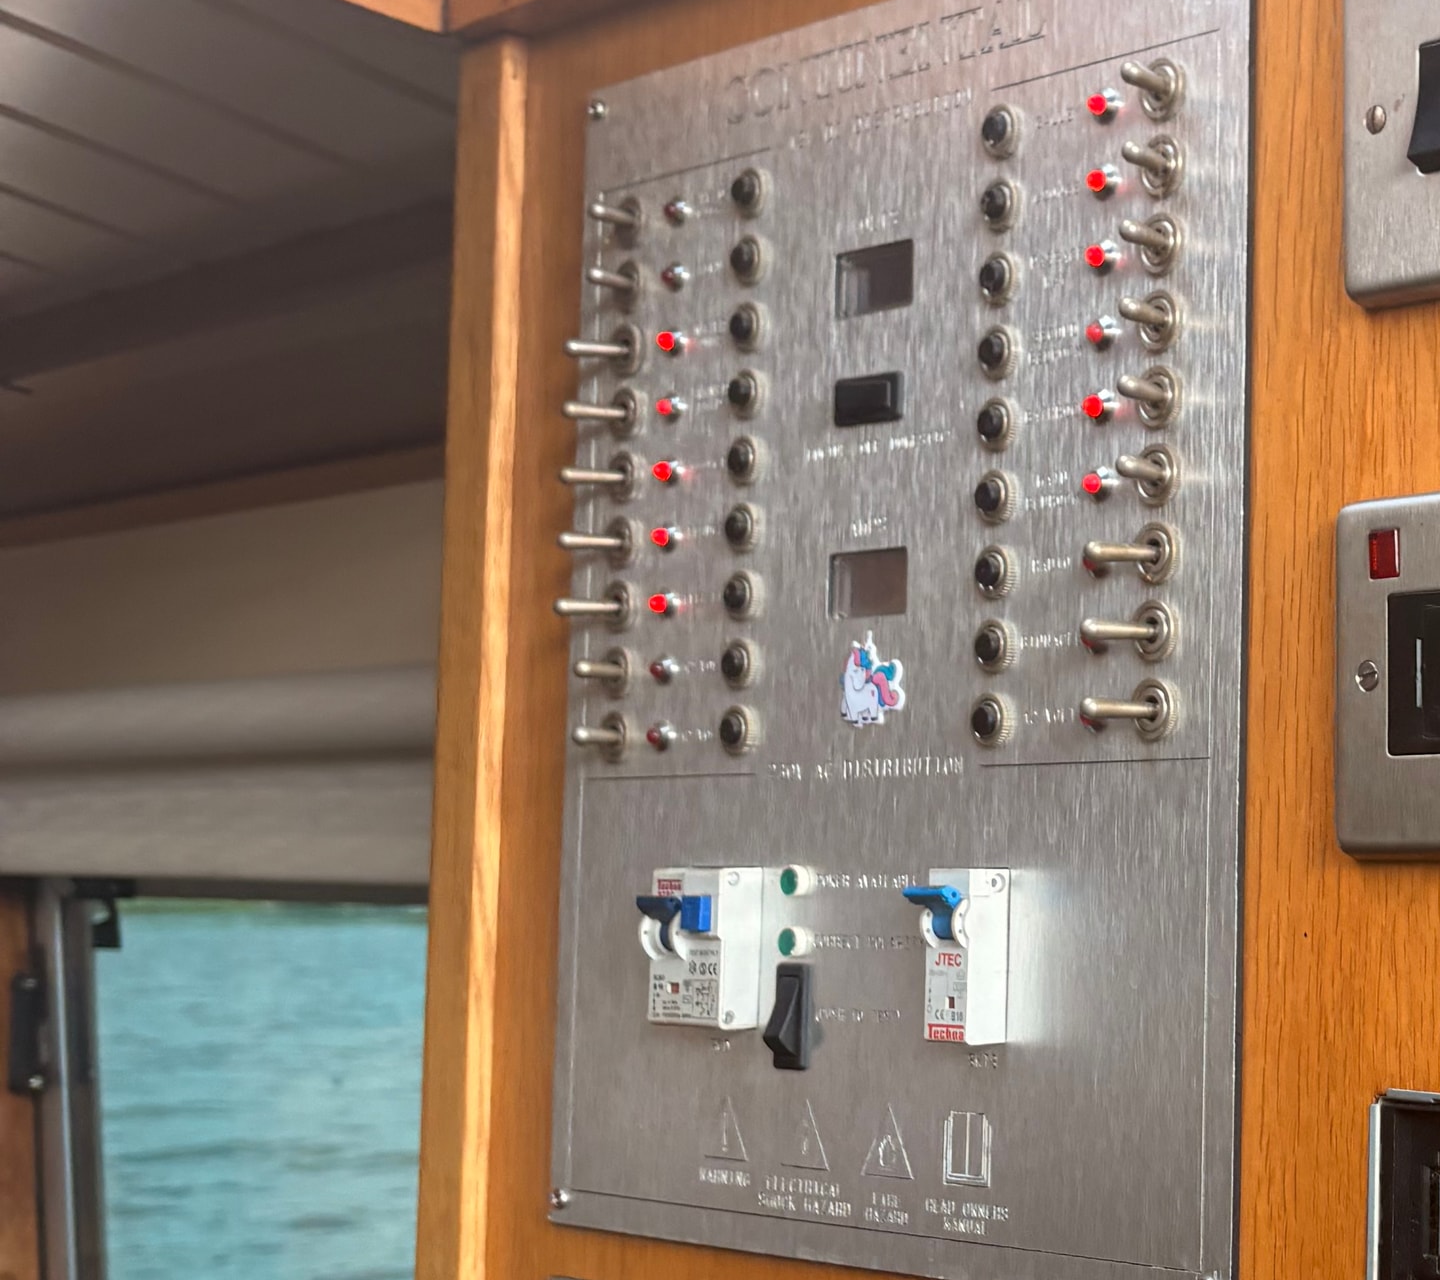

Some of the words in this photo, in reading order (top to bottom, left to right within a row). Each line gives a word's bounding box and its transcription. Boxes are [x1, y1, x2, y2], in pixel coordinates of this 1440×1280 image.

[843, 756, 965, 780] DISTRIBUTION
[935, 952, 962, 967] JTEC
[928, 1023, 965, 1041] Techna
[699, 1167, 750, 1187] WARNING
[765, 1175, 841, 1198] ELECTRICAL
[804, 1196, 852, 1217] HAZARD
